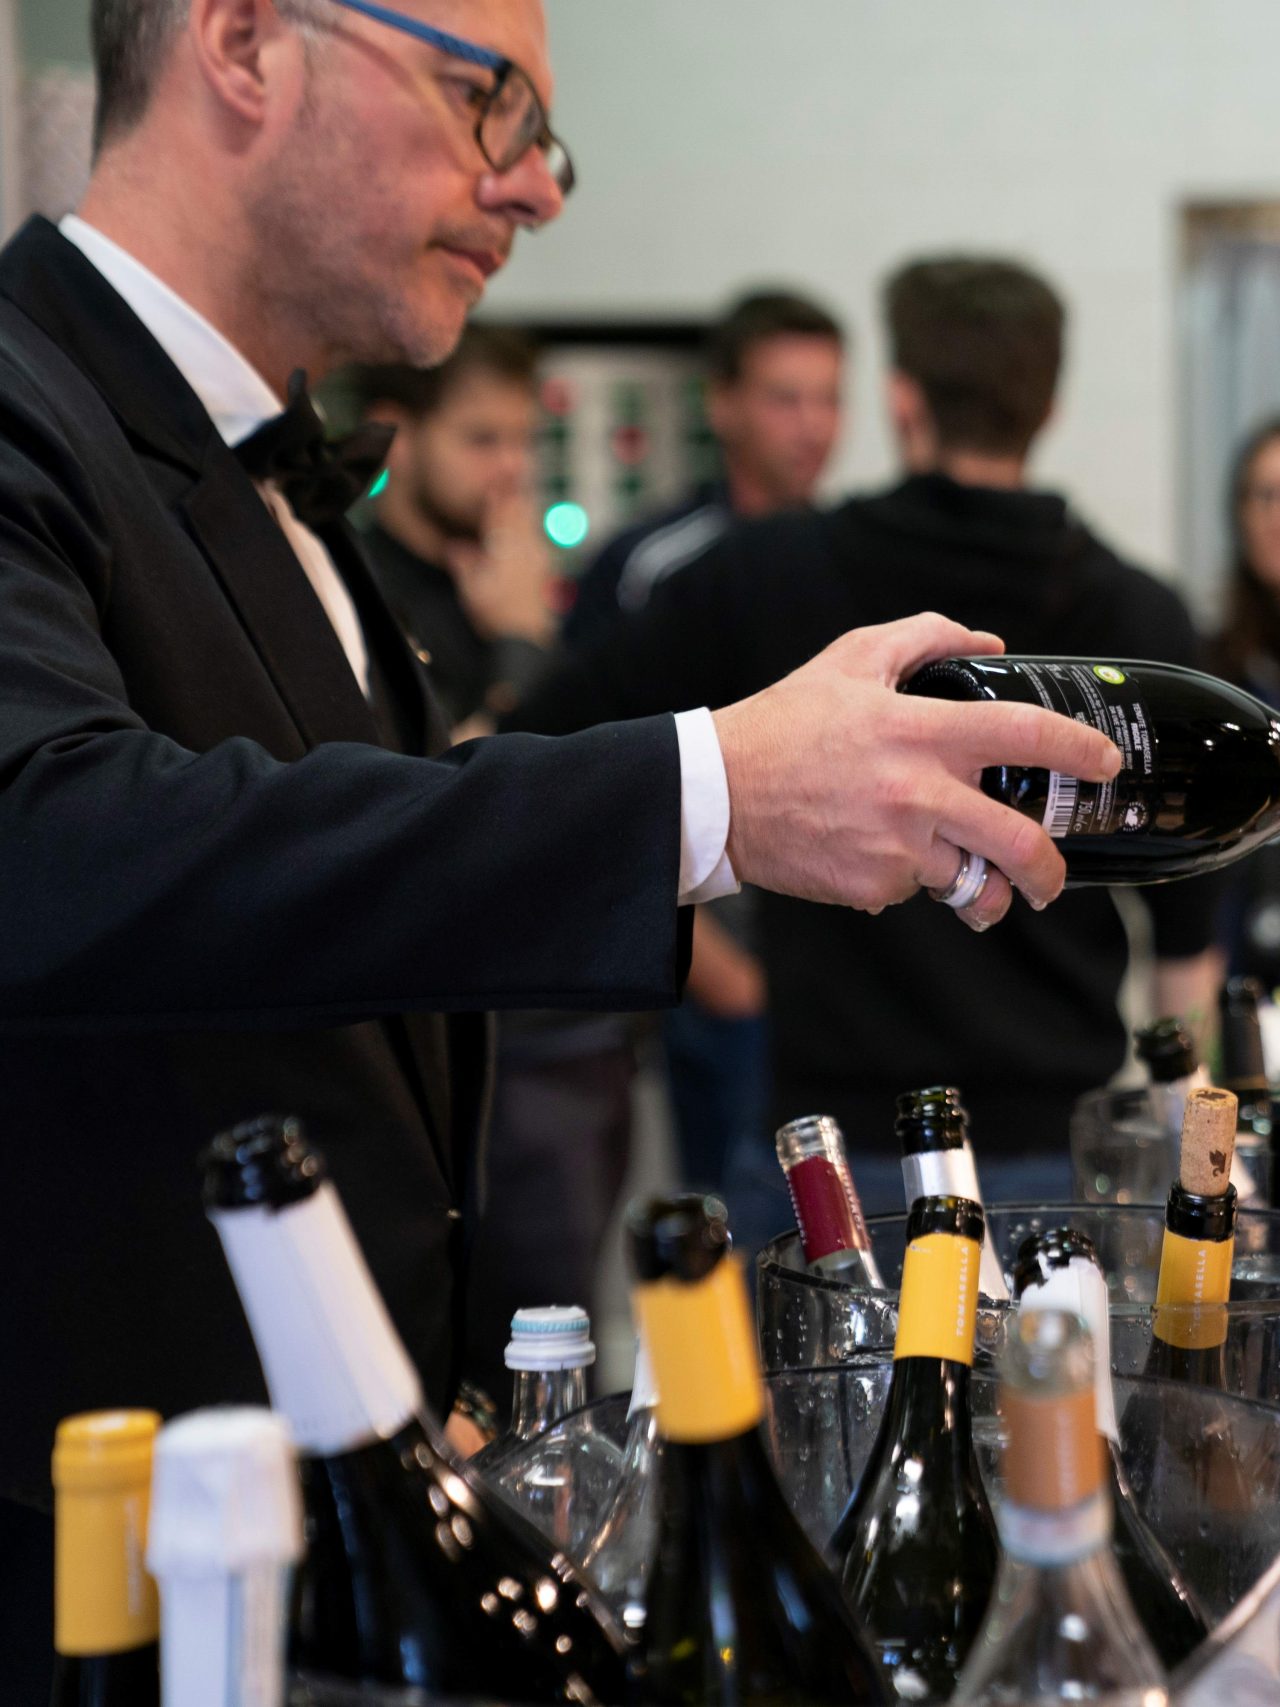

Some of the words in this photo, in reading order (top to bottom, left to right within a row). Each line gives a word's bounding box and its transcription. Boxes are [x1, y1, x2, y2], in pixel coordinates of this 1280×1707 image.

[1130, 722, 1142, 751] RIGOLE
[1132, 702, 1146, 729] TENUTE
[1140, 729, 1152, 775] TOMASELLA
[956, 1246, 968, 1337] TOMASELLA
